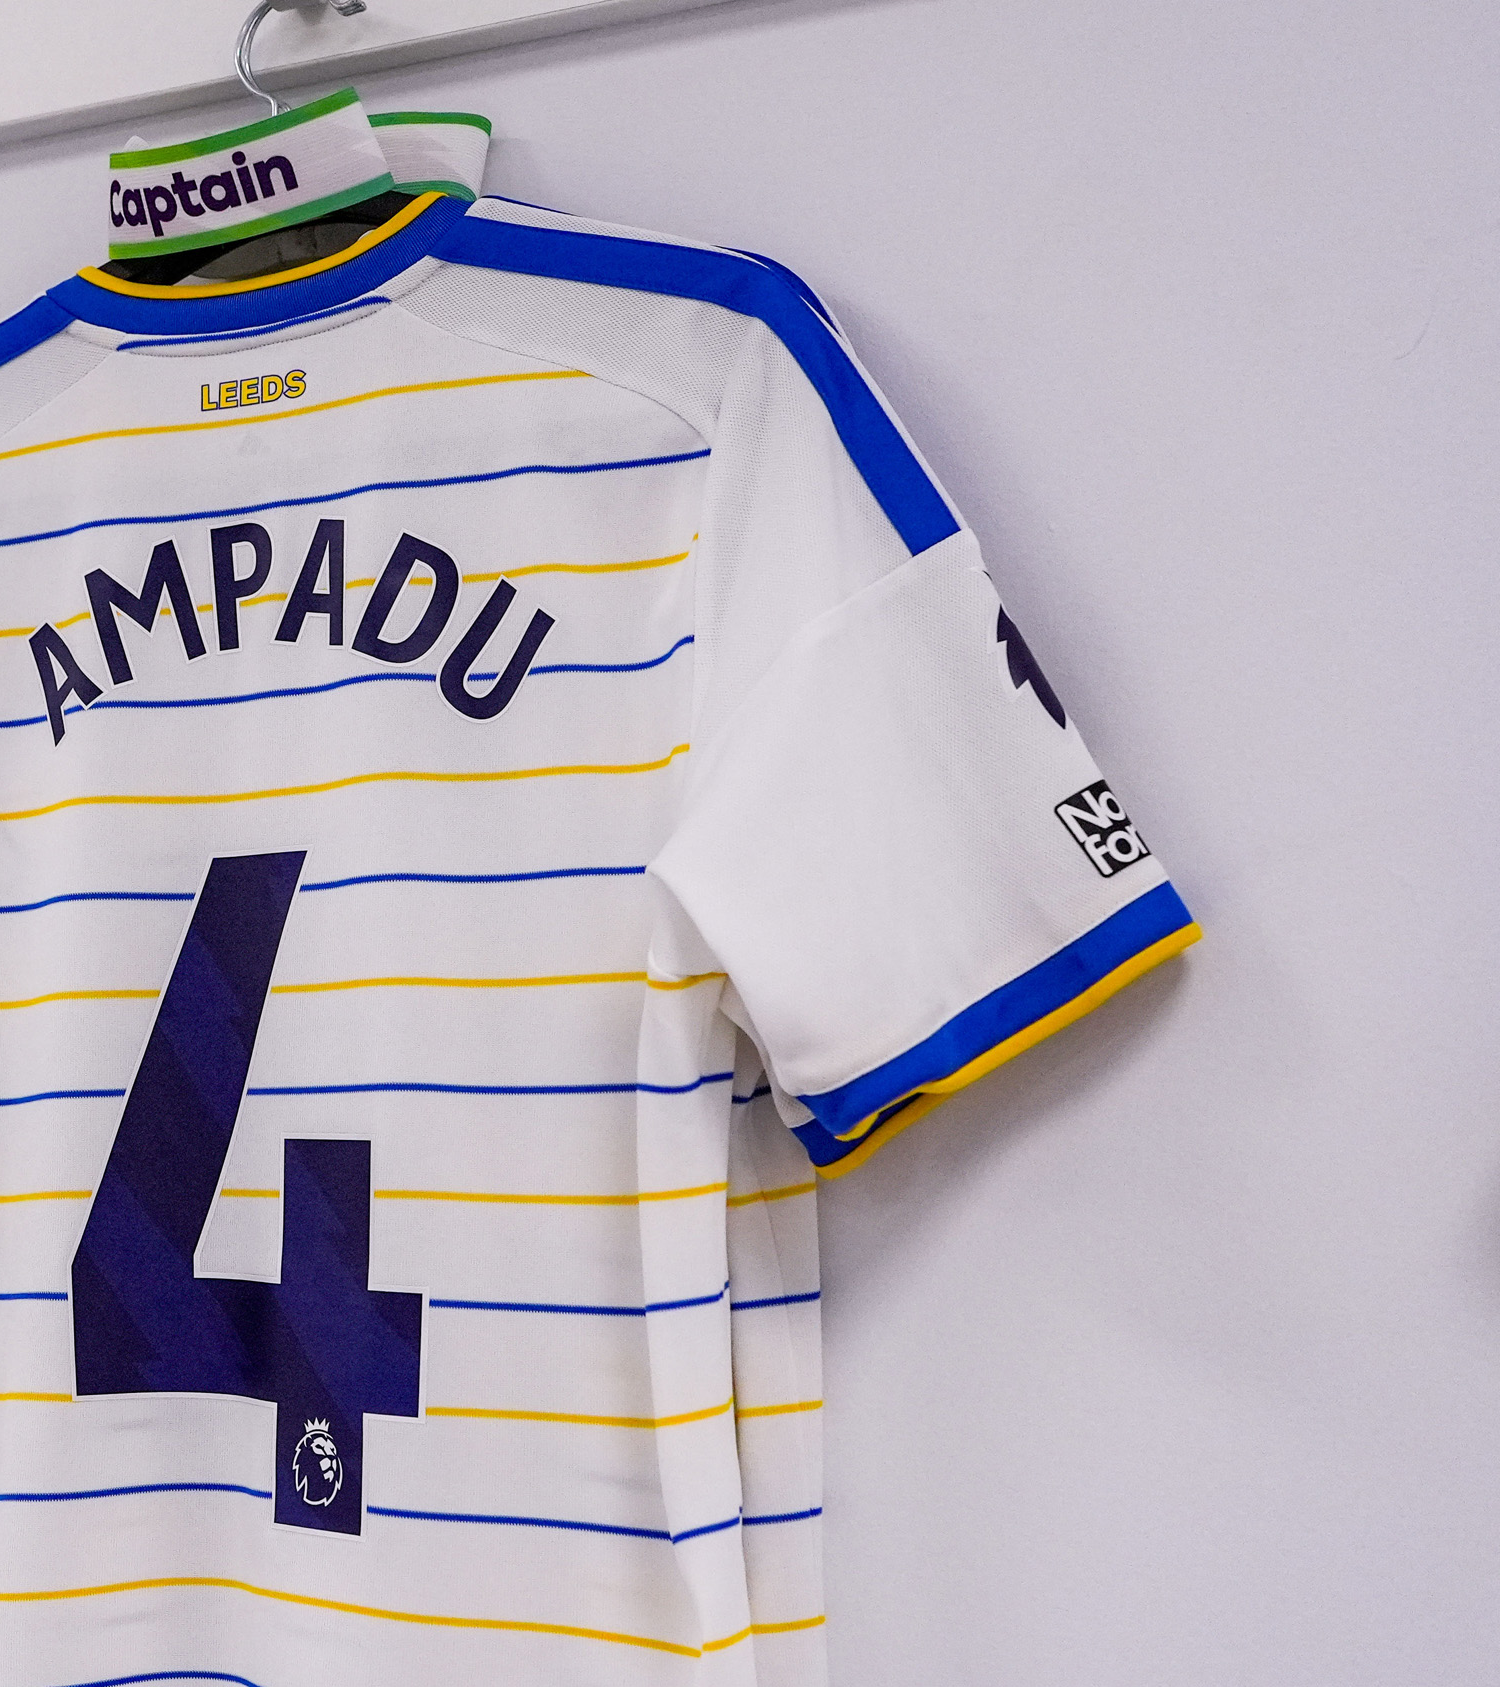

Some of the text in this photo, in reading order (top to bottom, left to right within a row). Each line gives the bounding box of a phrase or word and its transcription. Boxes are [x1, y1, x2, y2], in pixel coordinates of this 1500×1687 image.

[110, 151, 299, 236] Captain
[201, 369, 307, 411] LEEDS
[29, 518, 556, 746] AMPADU
[1056, 790, 1127, 843] No
[72, 850, 423, 1535] 4
